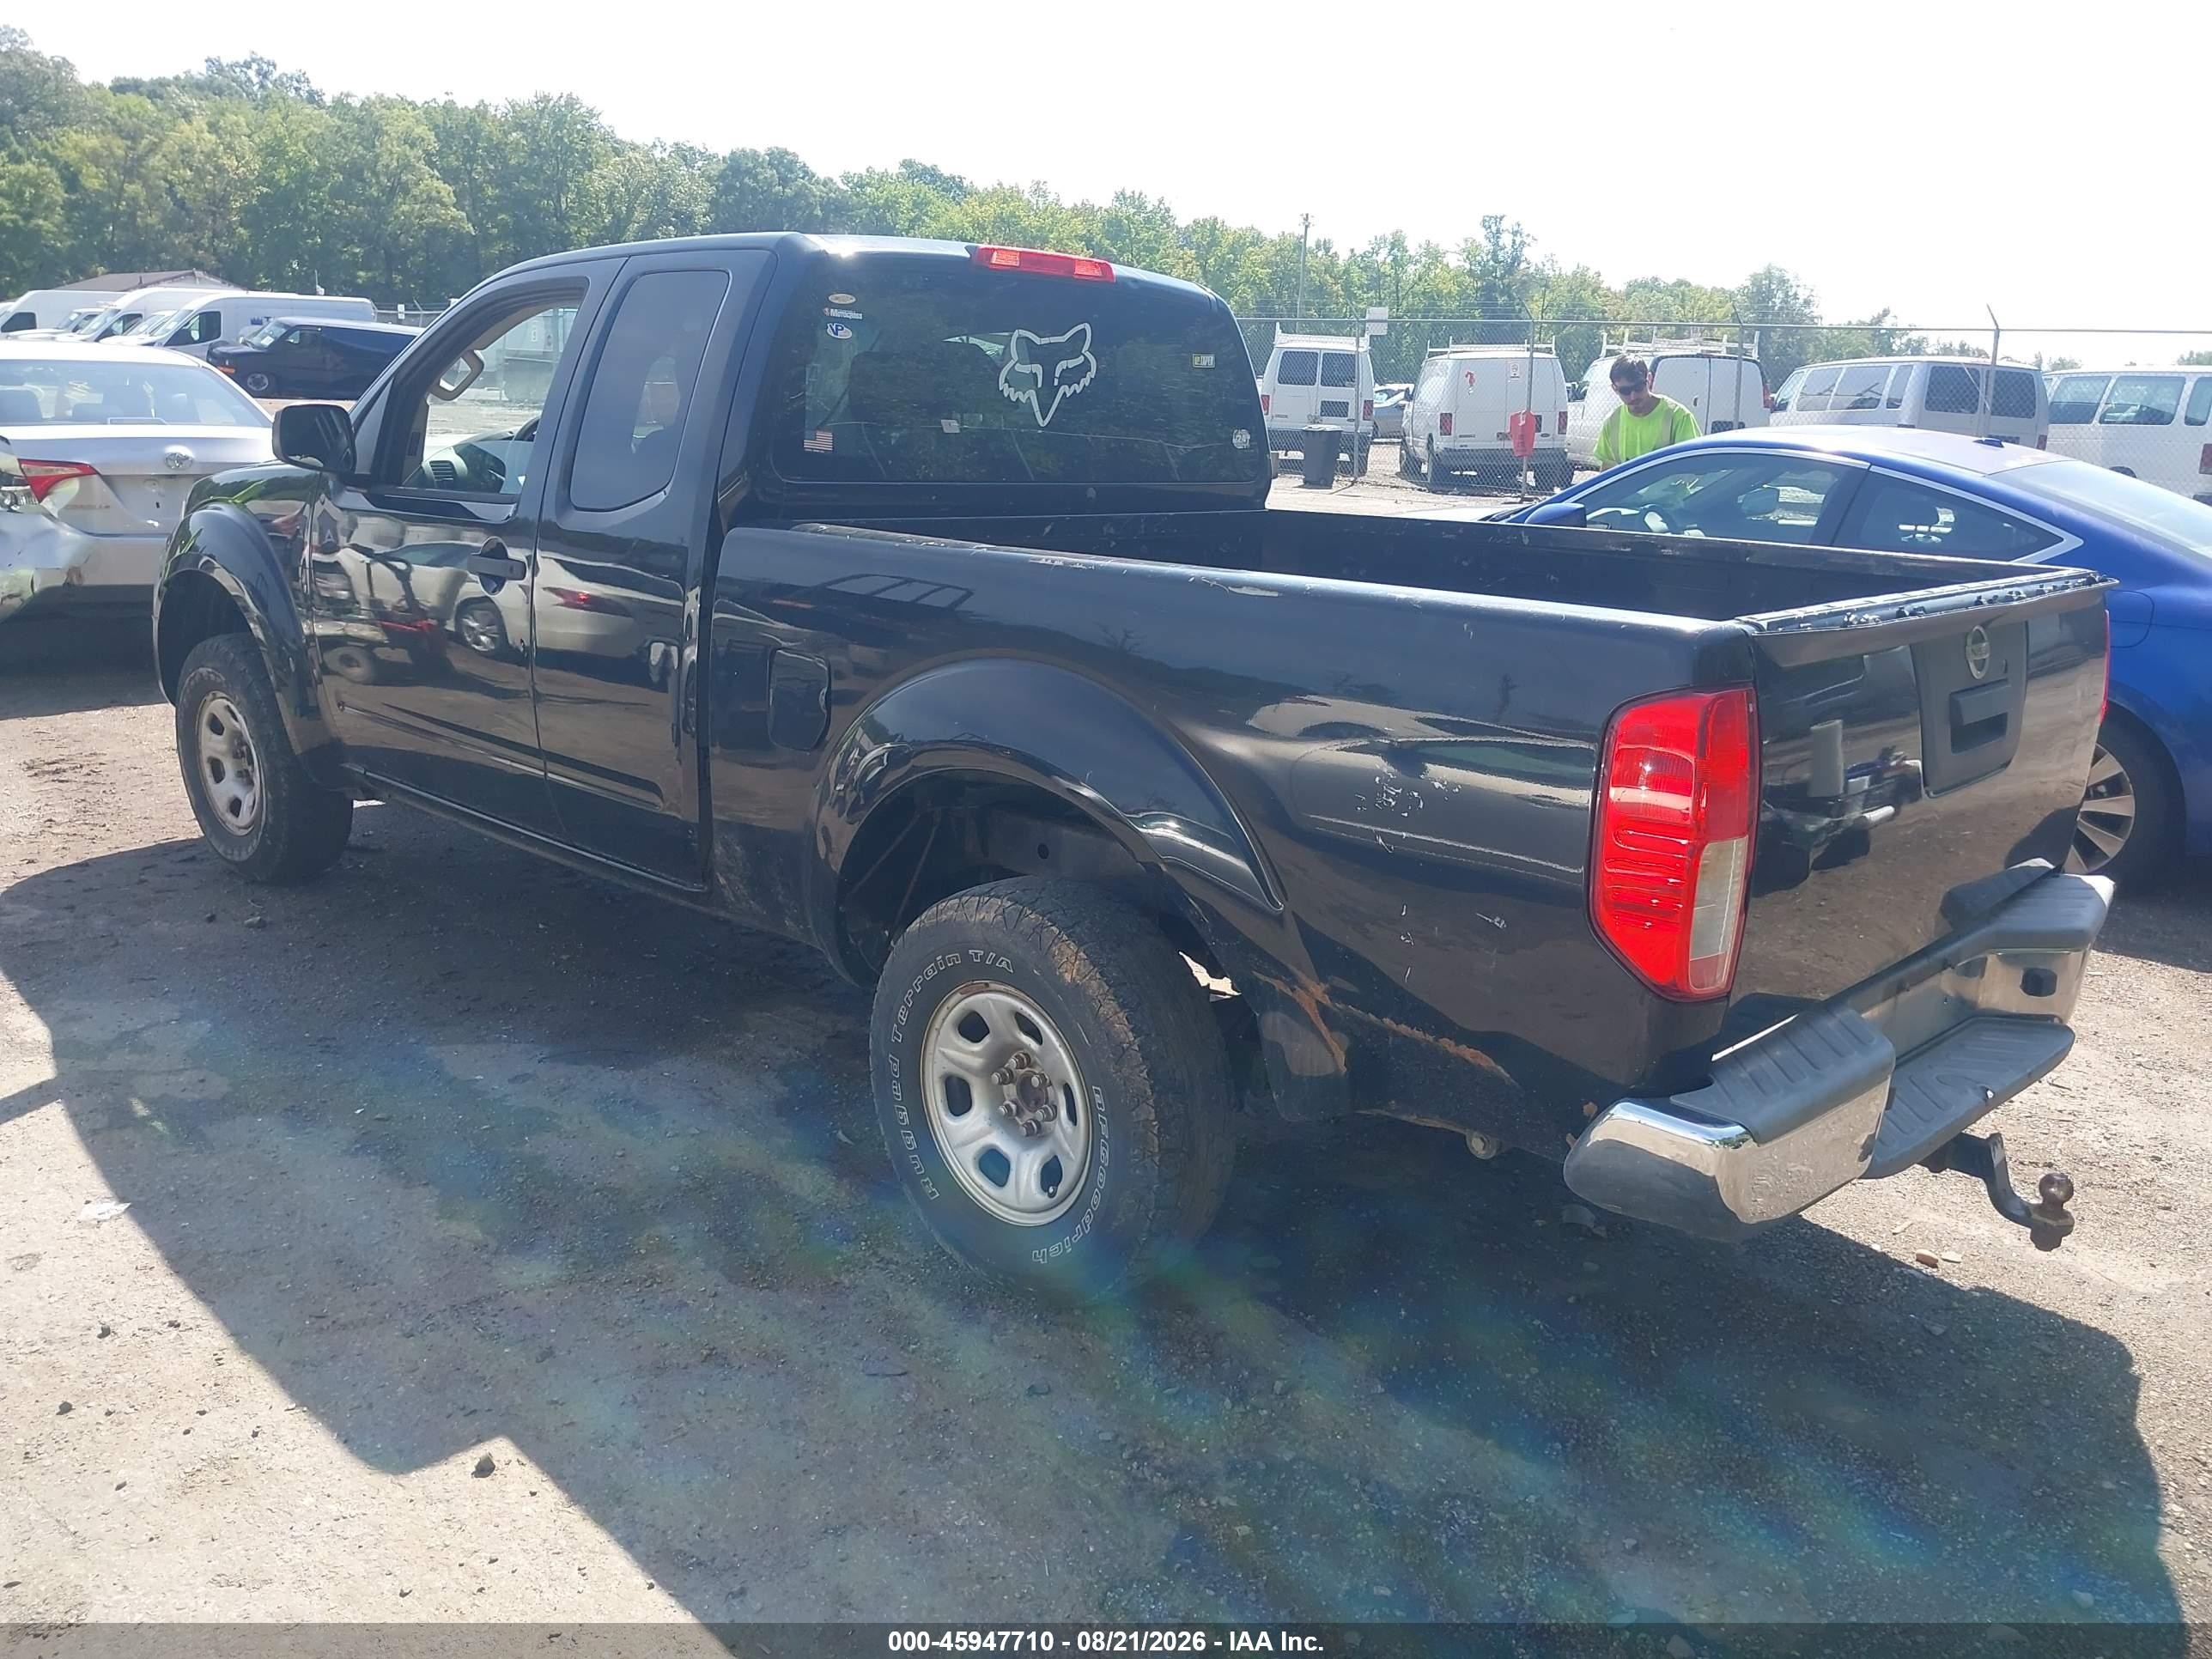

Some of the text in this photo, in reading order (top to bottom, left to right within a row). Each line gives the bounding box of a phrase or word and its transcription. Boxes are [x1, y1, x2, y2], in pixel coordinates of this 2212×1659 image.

[888, 948, 1014, 1200] Rugged Terrain T/A
[1031, 1085, 1109, 1265] BFGoodrich
